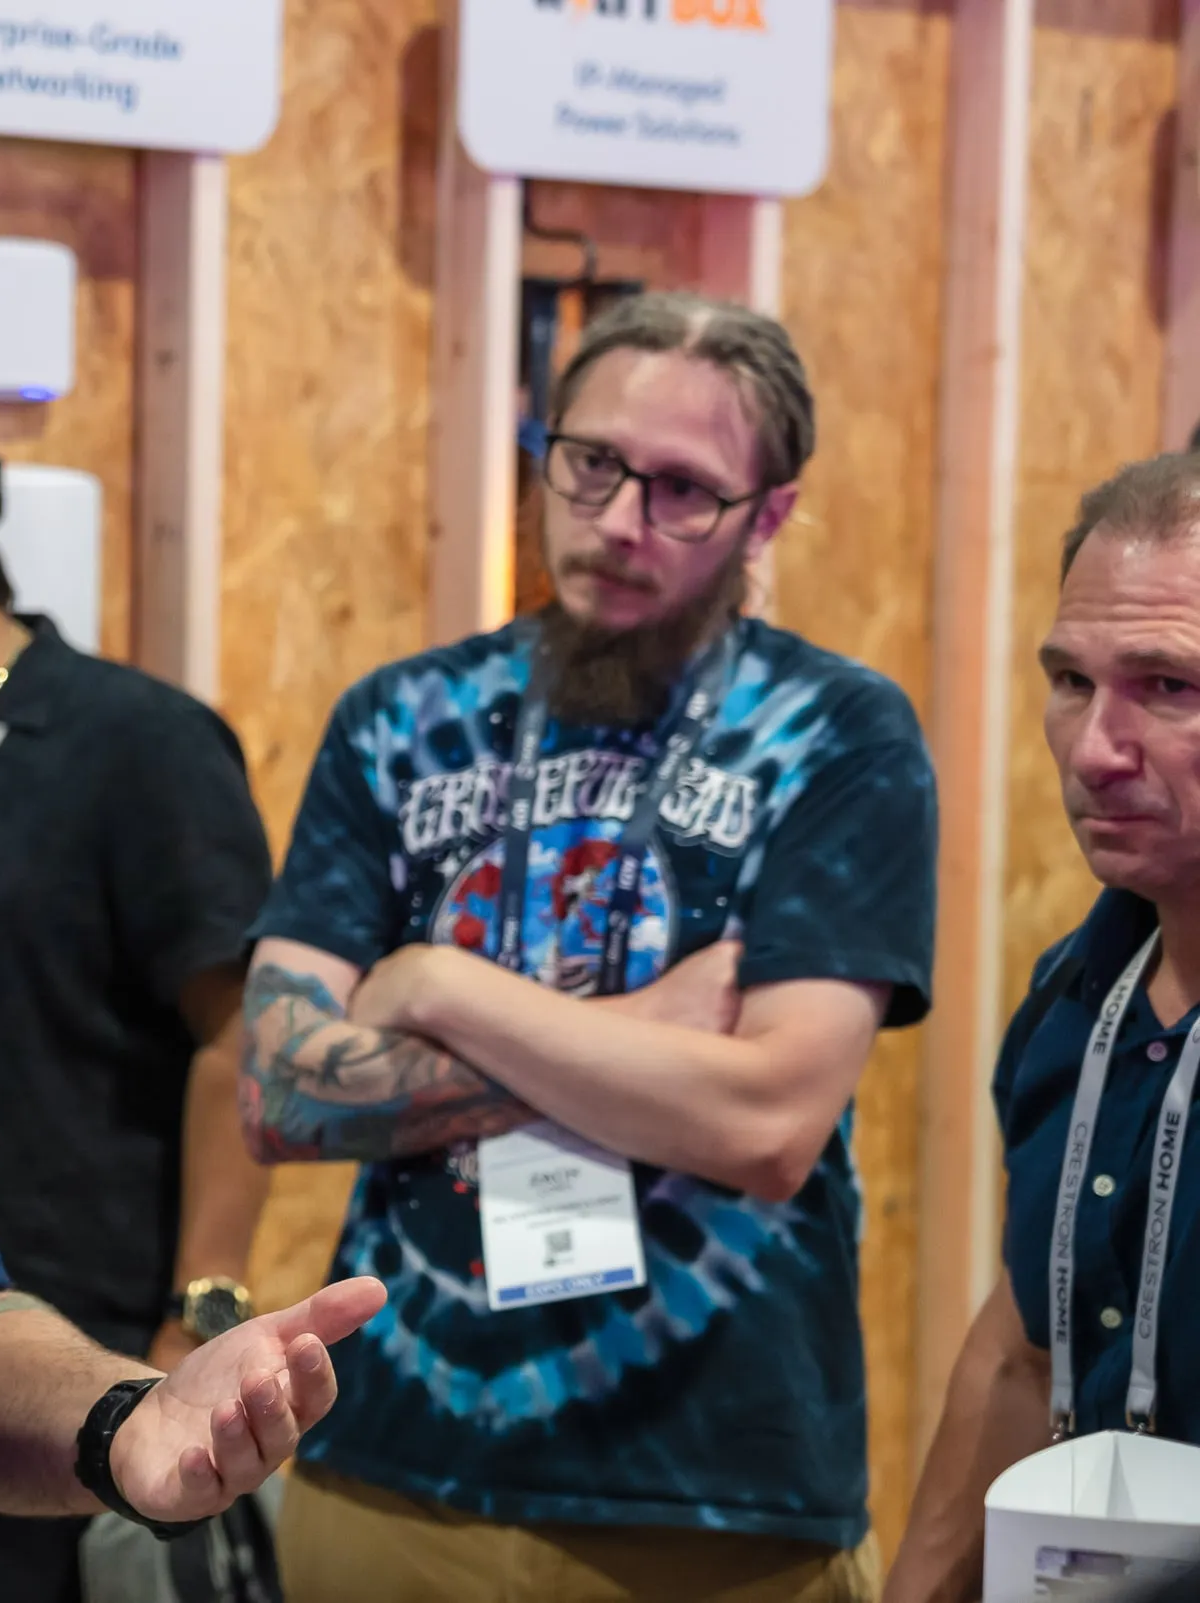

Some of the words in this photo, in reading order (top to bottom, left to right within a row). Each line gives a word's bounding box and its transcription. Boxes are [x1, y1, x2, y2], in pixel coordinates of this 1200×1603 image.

[554, 102, 626, 136] Power
[1057, 1121, 1088, 1260] CRESTRON
[1138, 1199, 1166, 1340] CRESTRON
[1156, 1111, 1181, 1191] HOME
[1055, 1266, 1069, 1345] HOME
